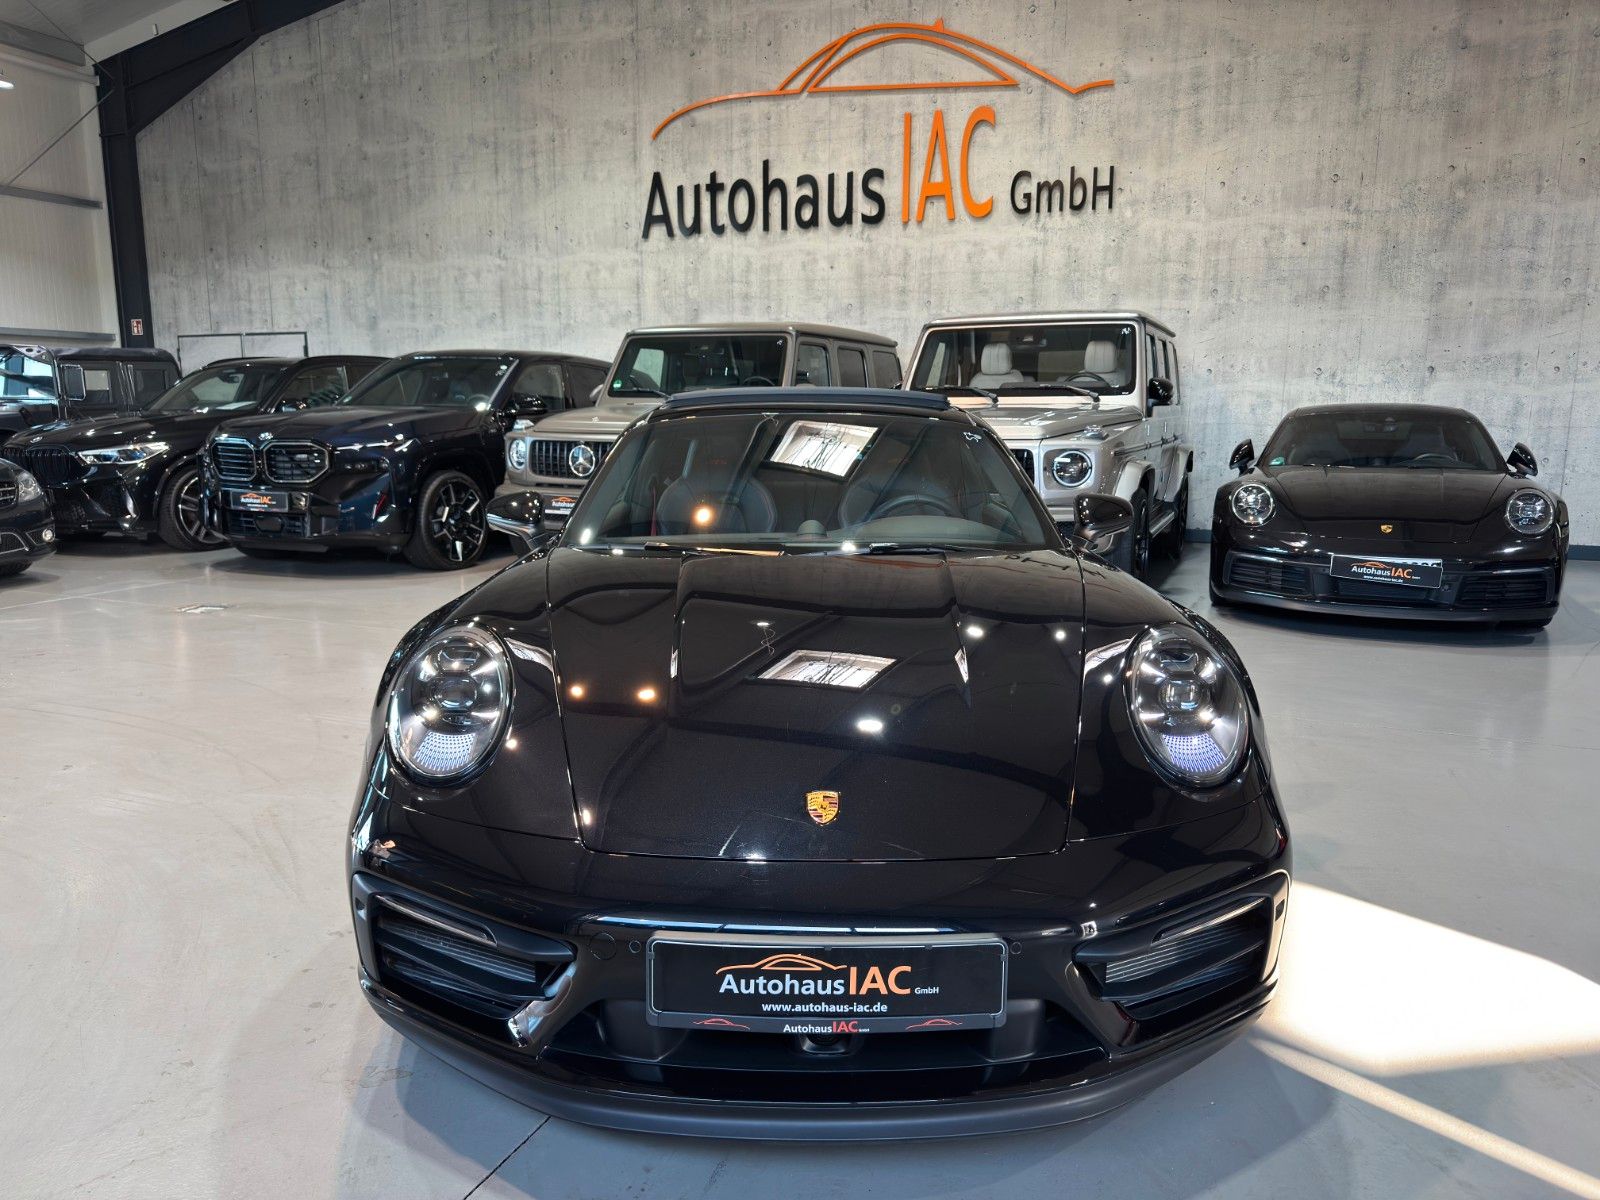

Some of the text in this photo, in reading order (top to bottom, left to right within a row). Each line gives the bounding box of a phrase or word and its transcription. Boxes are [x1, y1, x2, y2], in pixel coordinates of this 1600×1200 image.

[642, 106, 1115, 239] Autohaus IAC GmbH
[1351, 565, 1412, 579] Autohaus IAC
[719, 966, 939, 995] Autohaus IAC GmbH
[761, 1001, 888, 1012] www.autohaus-iac.de
[783, 1020, 858, 1033] Autohaus IAC
